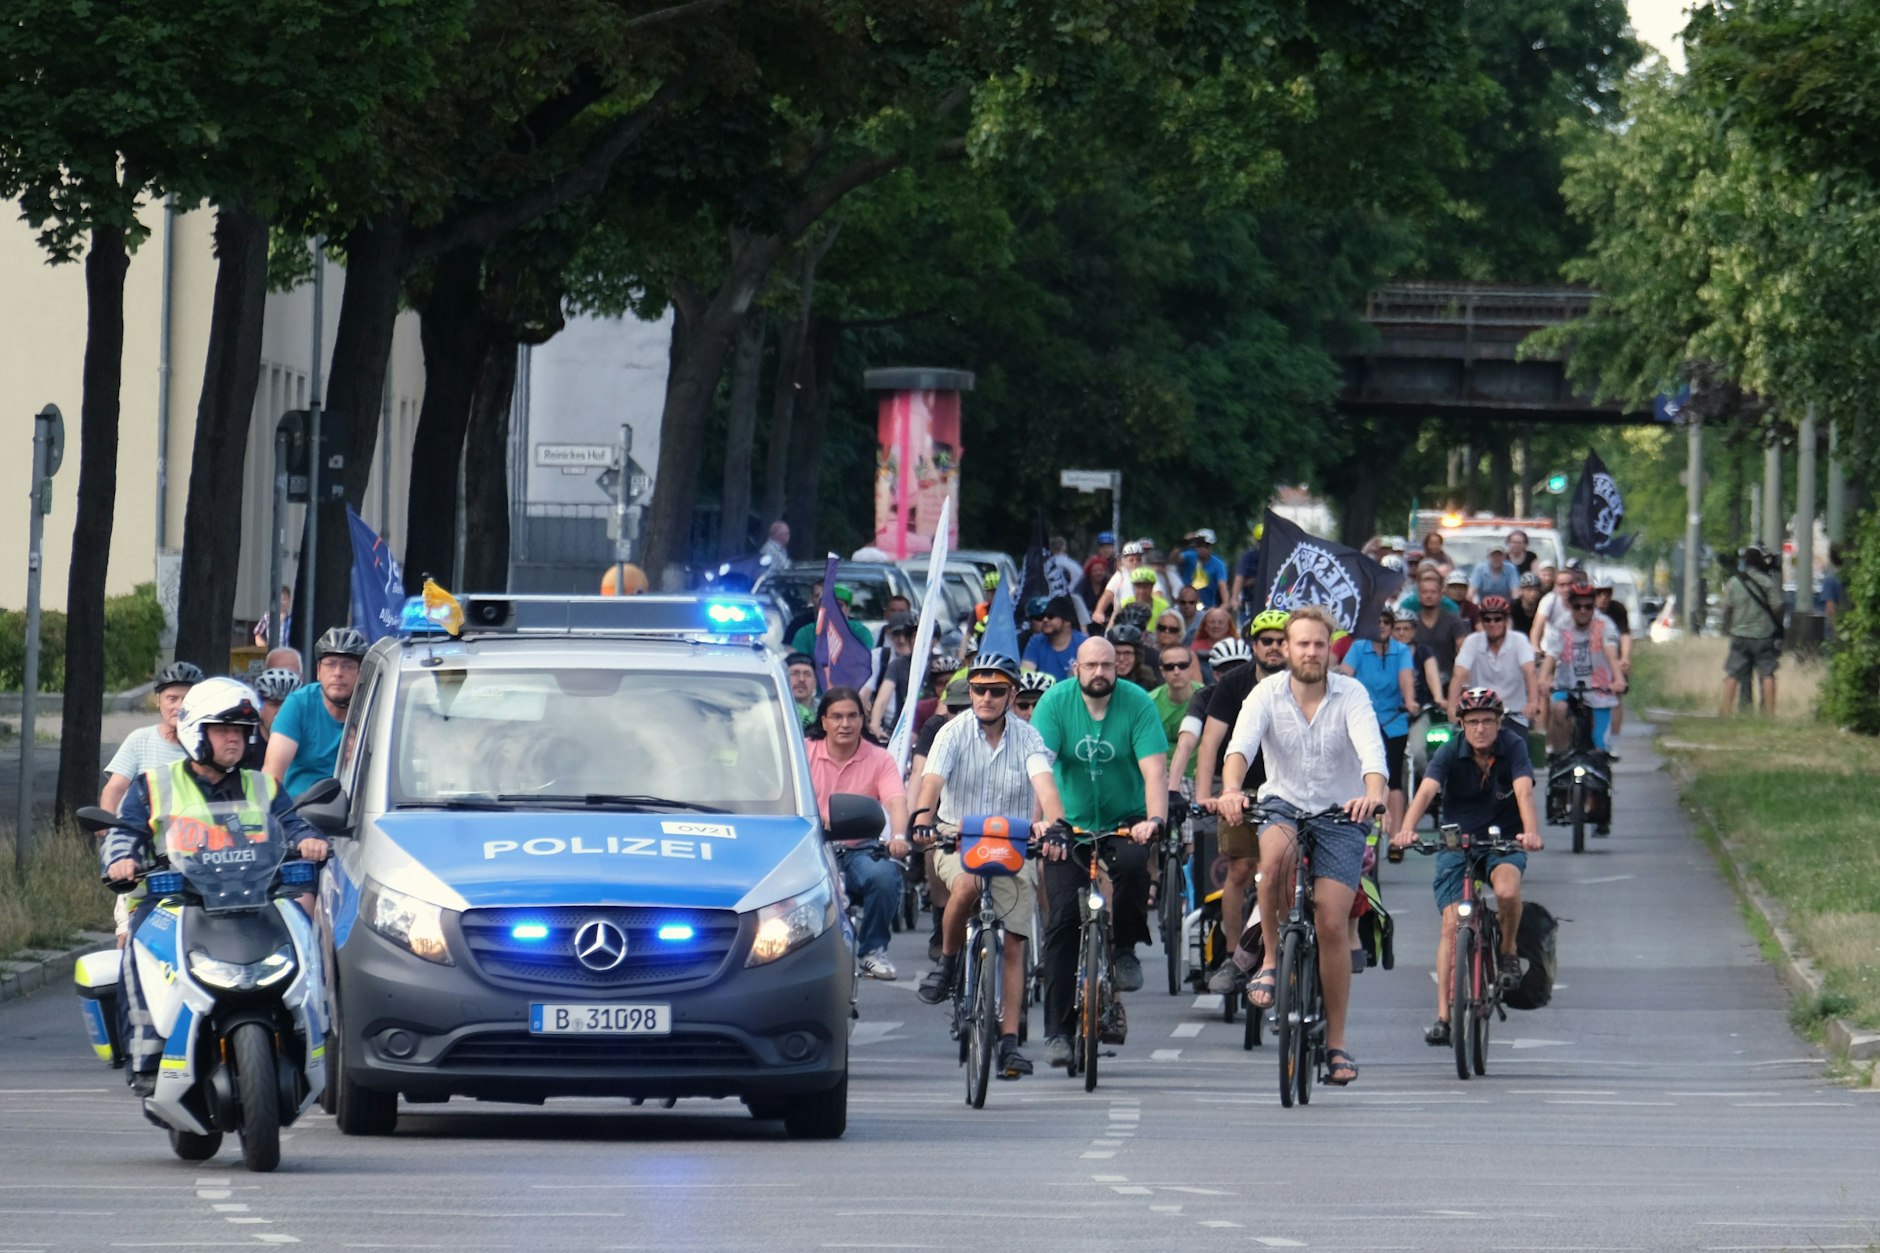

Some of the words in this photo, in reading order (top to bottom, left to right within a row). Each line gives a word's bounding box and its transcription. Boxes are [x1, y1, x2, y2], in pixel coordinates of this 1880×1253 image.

[543, 449, 586, 461] Reinickes
[587, 449, 606, 461] Hof
[202, 849, 256, 865] POLIZEI
[483, 836, 712, 861] POLIZEI
[555, 1008, 570, 1030] B
[586, 1008, 657, 1030] 31098
